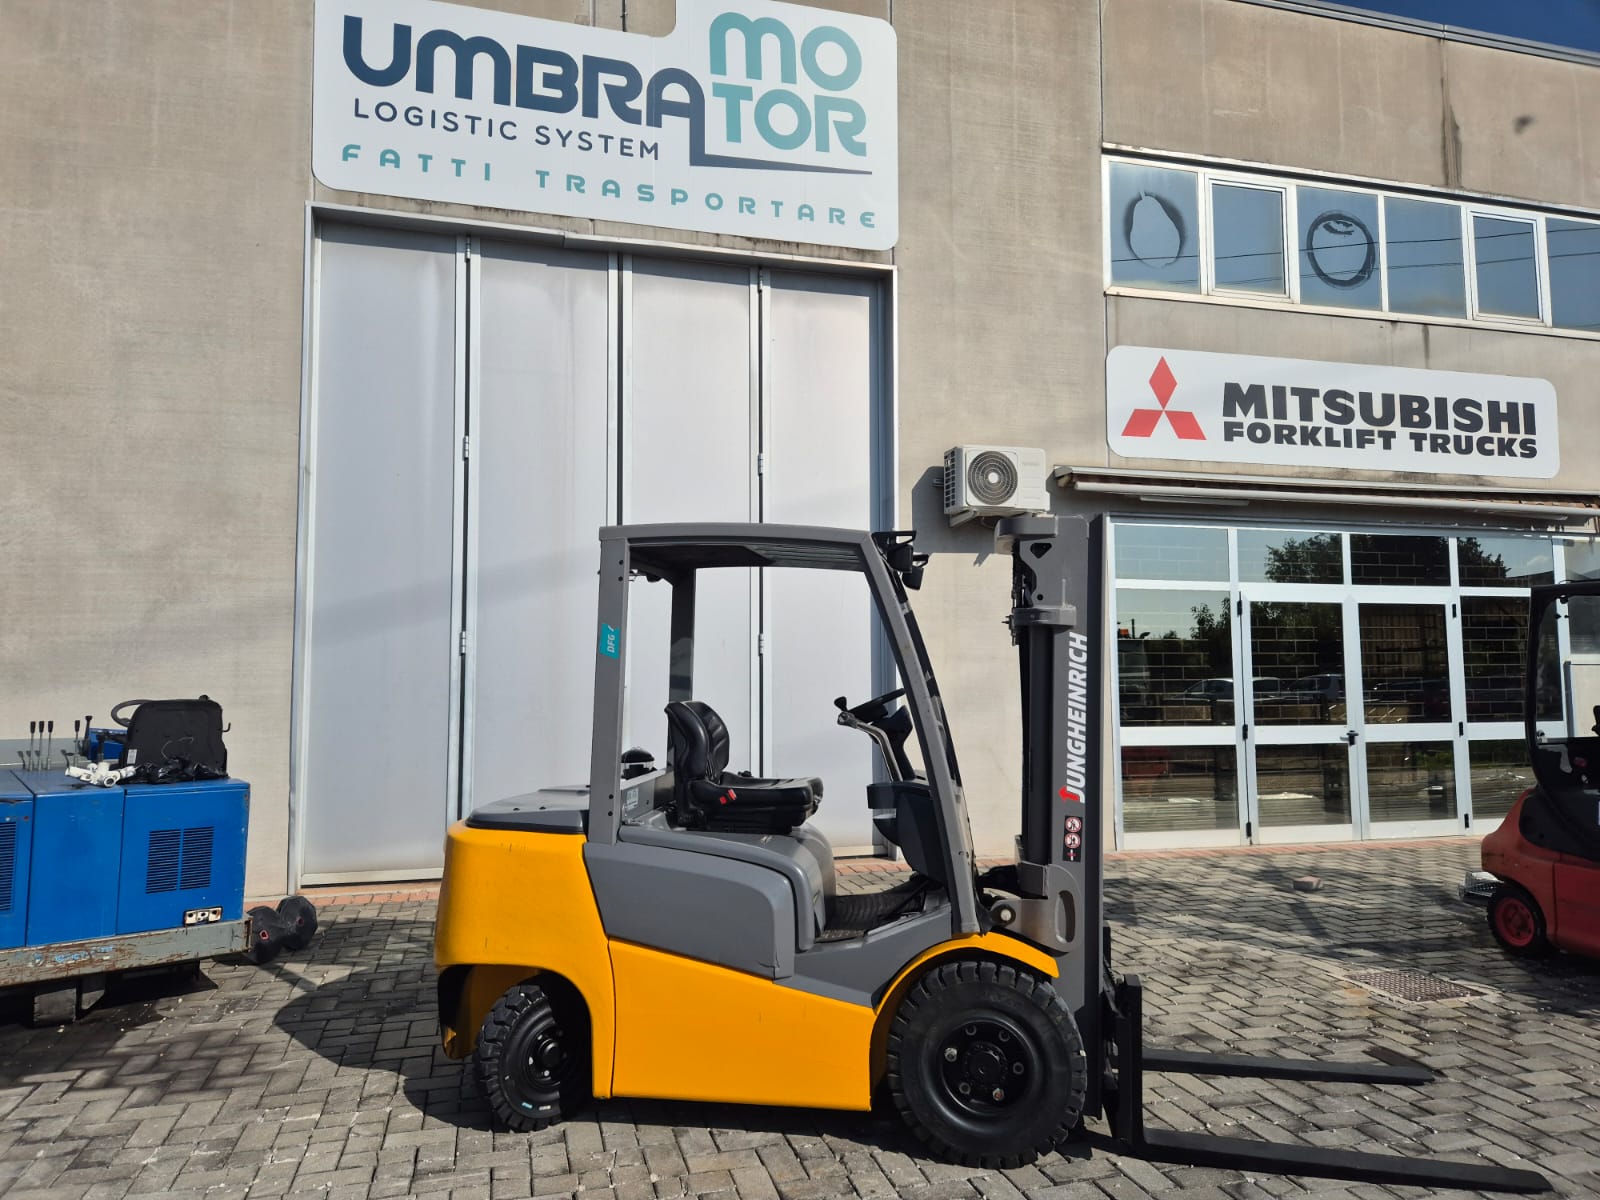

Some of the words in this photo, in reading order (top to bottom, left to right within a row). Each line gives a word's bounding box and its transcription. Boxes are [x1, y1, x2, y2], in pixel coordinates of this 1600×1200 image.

[342, 14, 706, 152] UMBRA
[711, 81, 868, 157] TOR
[354, 98, 517, 141] LOGISTIC
[535, 125, 660, 161] SYSTEM
[341, 143, 492, 182] FATTI
[536, 169, 876, 229] TRASPORTARE
[1222, 382, 1537, 436] MITSUBISHI
[1223, 421, 1397, 451] FORKLIFT
[1409, 431, 1538, 459] TRUCKS
[1065, 631, 1088, 804] JUNGHEINRICH
